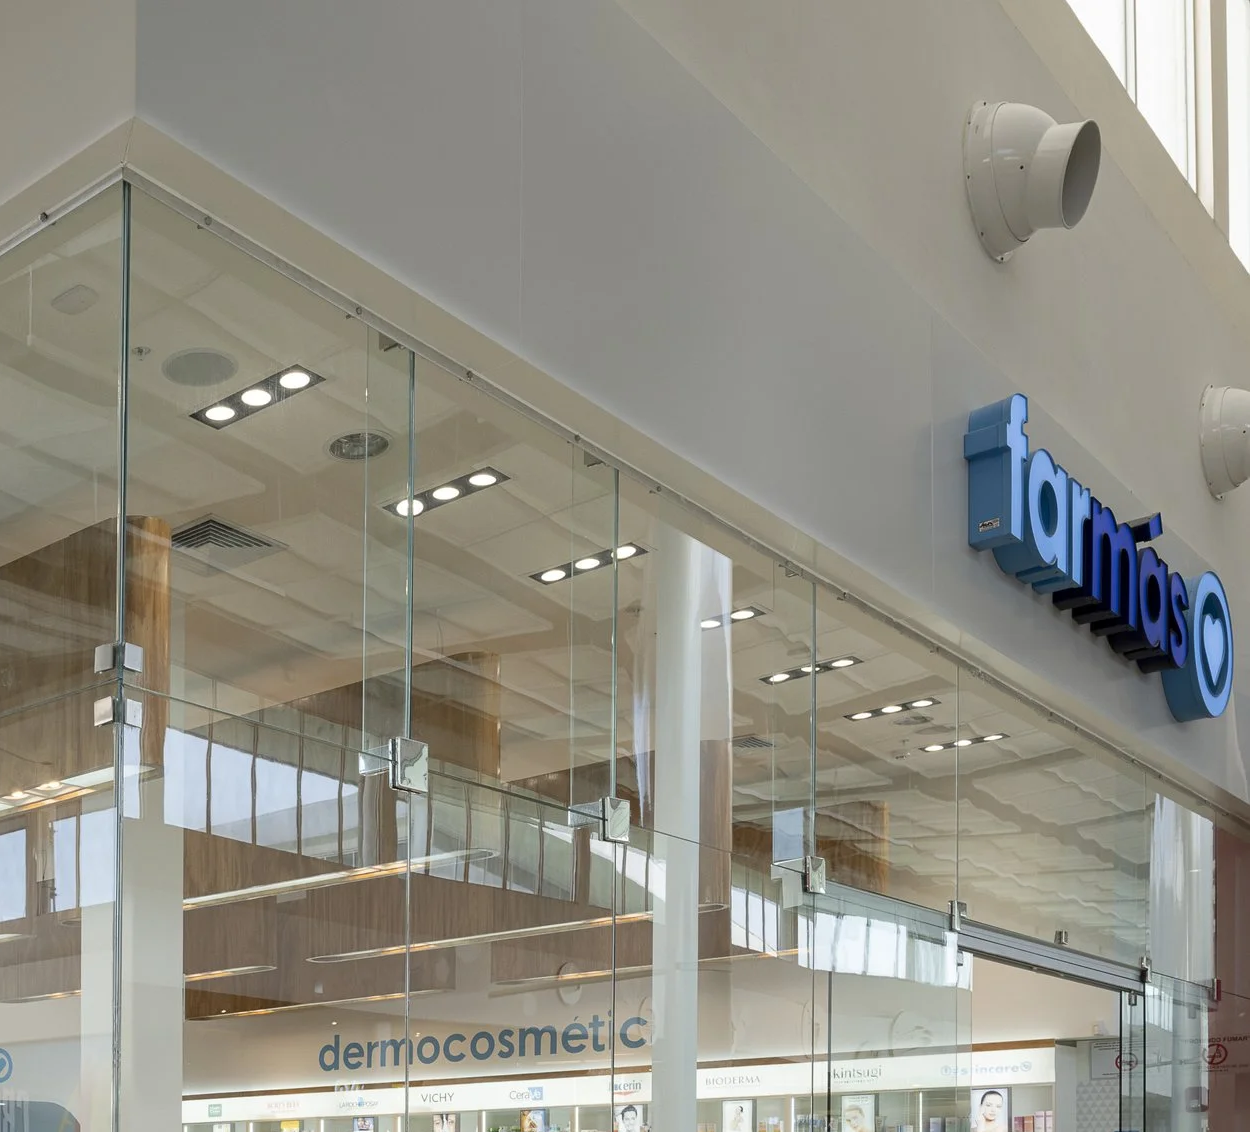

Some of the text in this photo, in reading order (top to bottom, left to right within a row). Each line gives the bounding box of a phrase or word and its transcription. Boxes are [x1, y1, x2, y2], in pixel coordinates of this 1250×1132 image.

[1002, 392, 1190, 670] farmás
[705, 1075, 761, 1087] BIODERMA
[421, 1092, 455, 1104] VICHY
[509, 1086, 543, 1101] CeraVe
